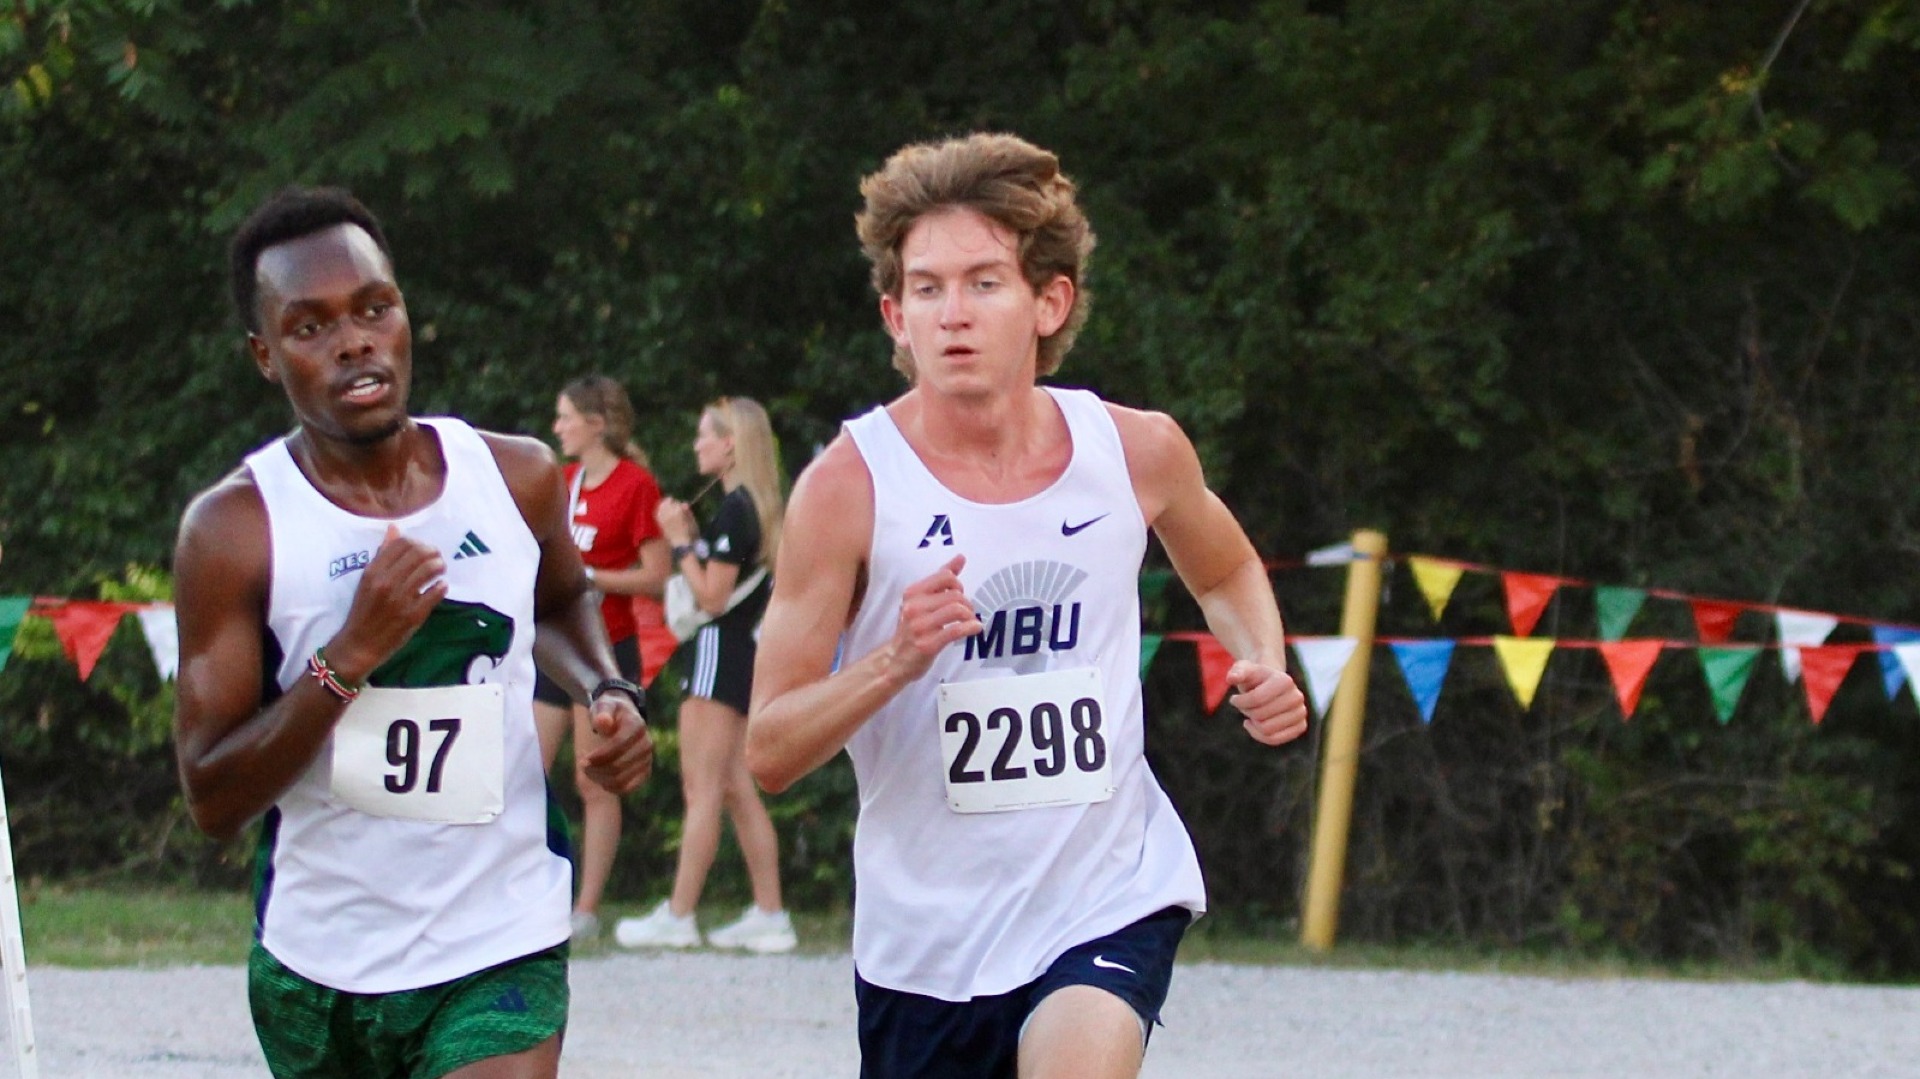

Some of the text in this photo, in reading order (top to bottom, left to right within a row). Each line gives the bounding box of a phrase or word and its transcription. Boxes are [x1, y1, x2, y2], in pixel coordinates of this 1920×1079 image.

[330, 551, 369, 577] NEC
[964, 602, 1081, 661] MBU
[384, 718, 461, 794] 97
[945, 697, 1107, 784] 2298
